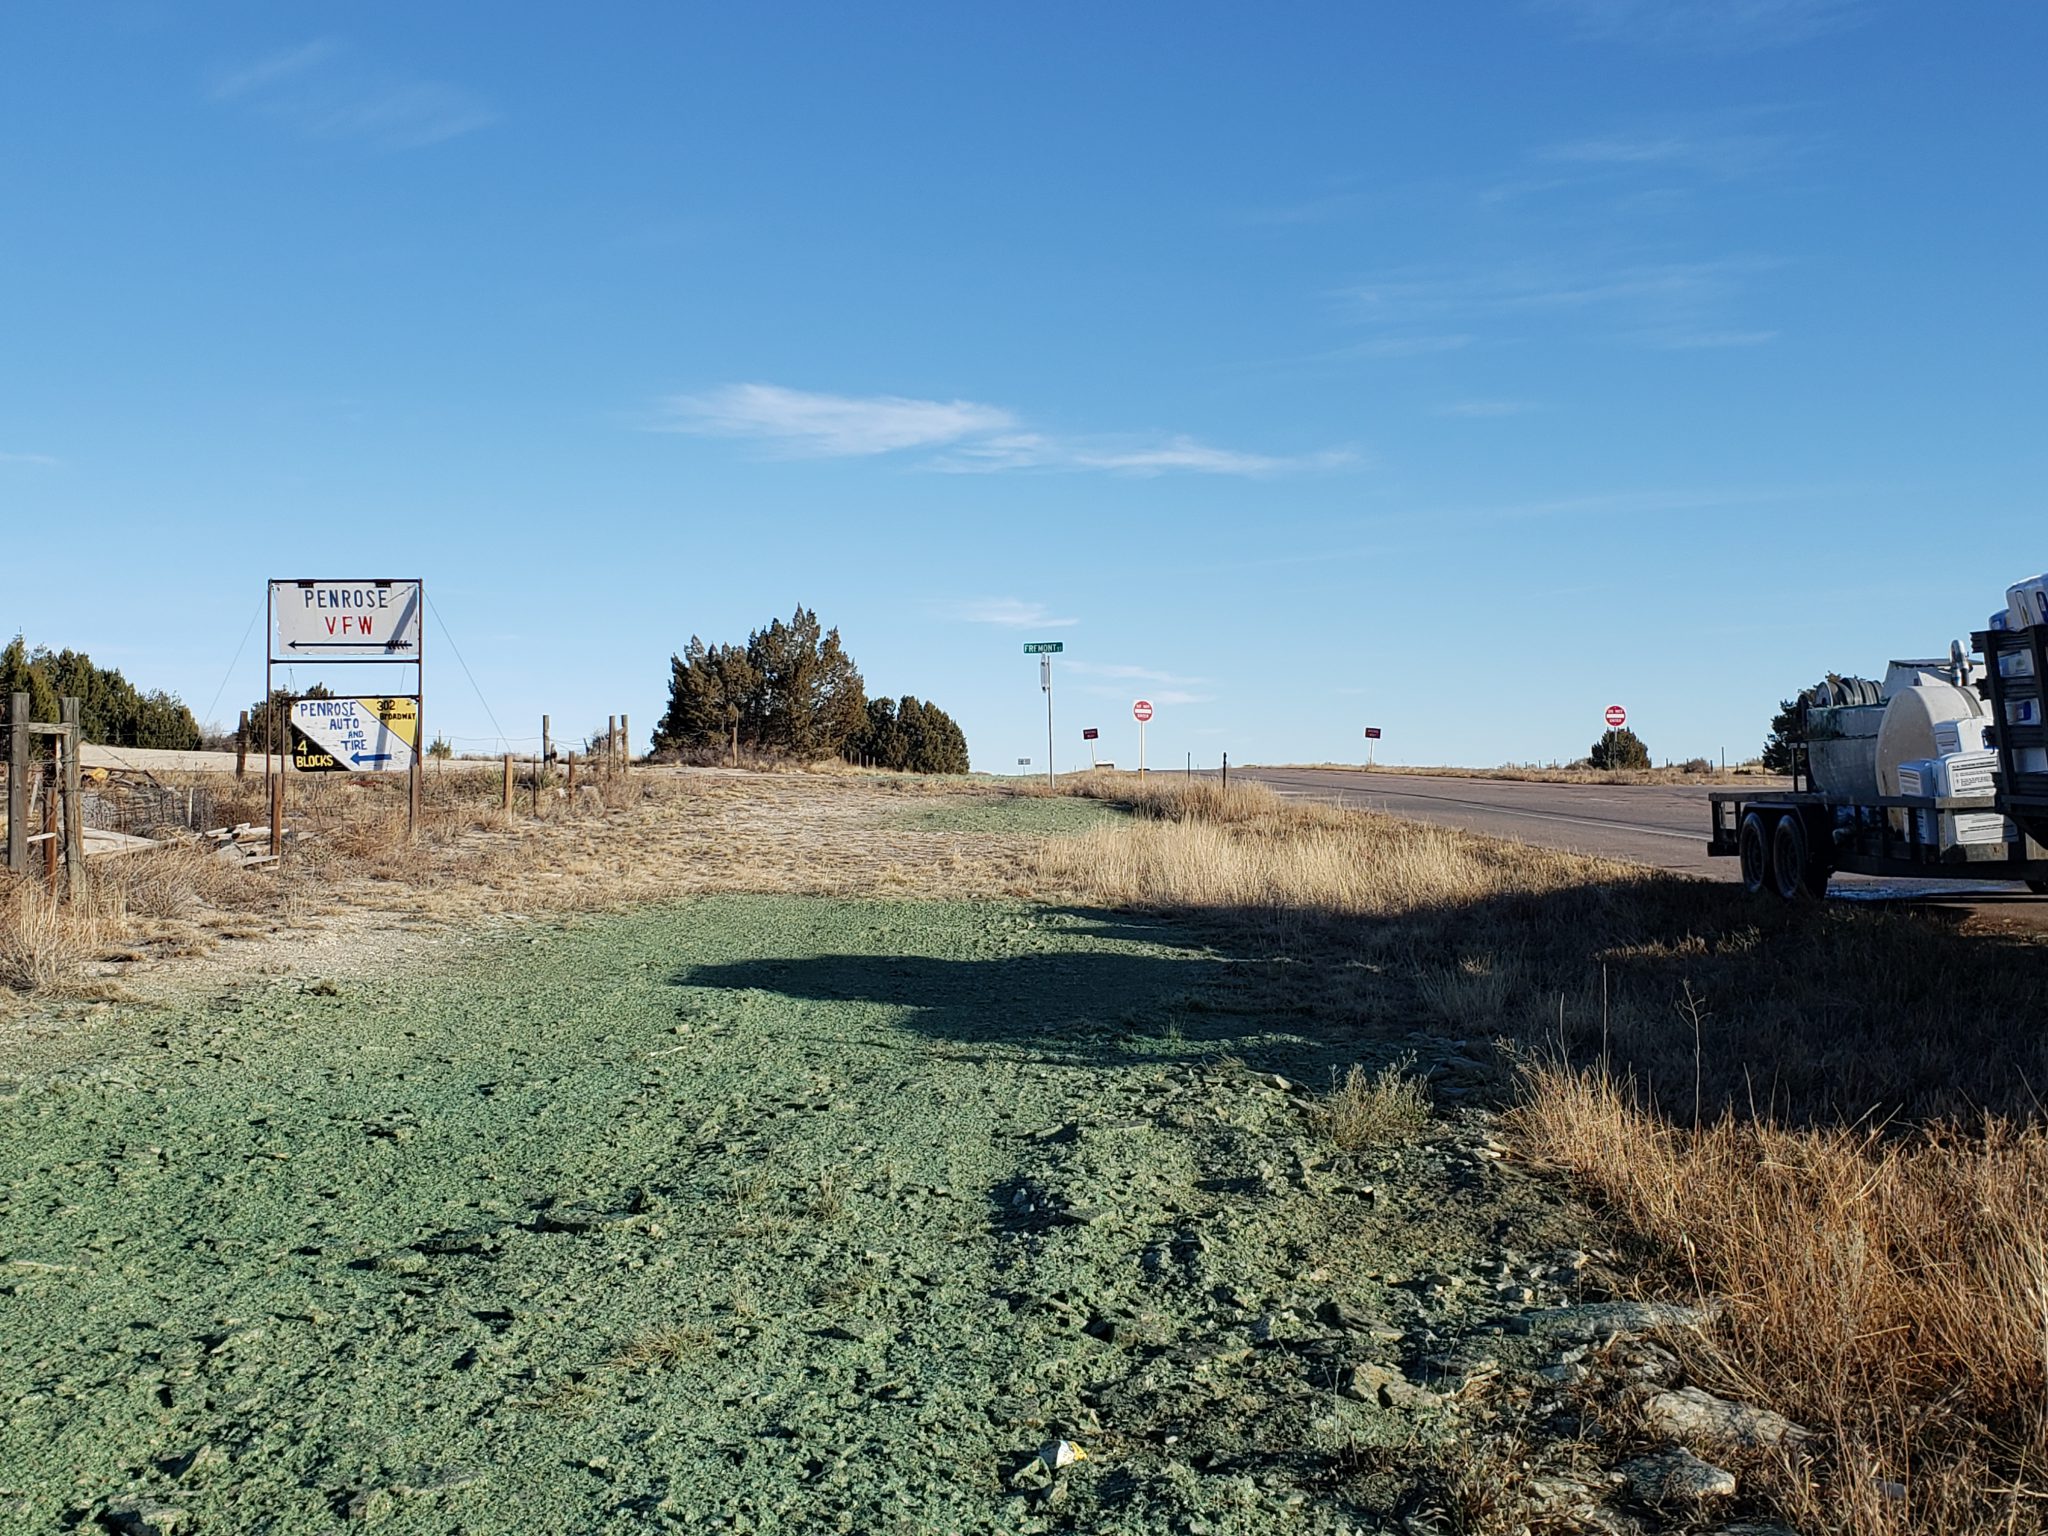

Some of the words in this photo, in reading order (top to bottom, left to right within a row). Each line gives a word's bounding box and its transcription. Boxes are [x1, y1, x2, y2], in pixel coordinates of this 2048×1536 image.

[305, 590, 388, 608] PENROSE
[1024, 644, 1056, 652] FREMONT
[301, 702, 356, 716] PENROSE
[377, 701, 395, 711] 302
[330, 718, 359, 730] AUTO
[348, 730, 364, 739] AND
[297, 740, 308, 755] 4
[340, 740, 367, 751] TIRE
[296, 755, 334, 768] BLOCKS
